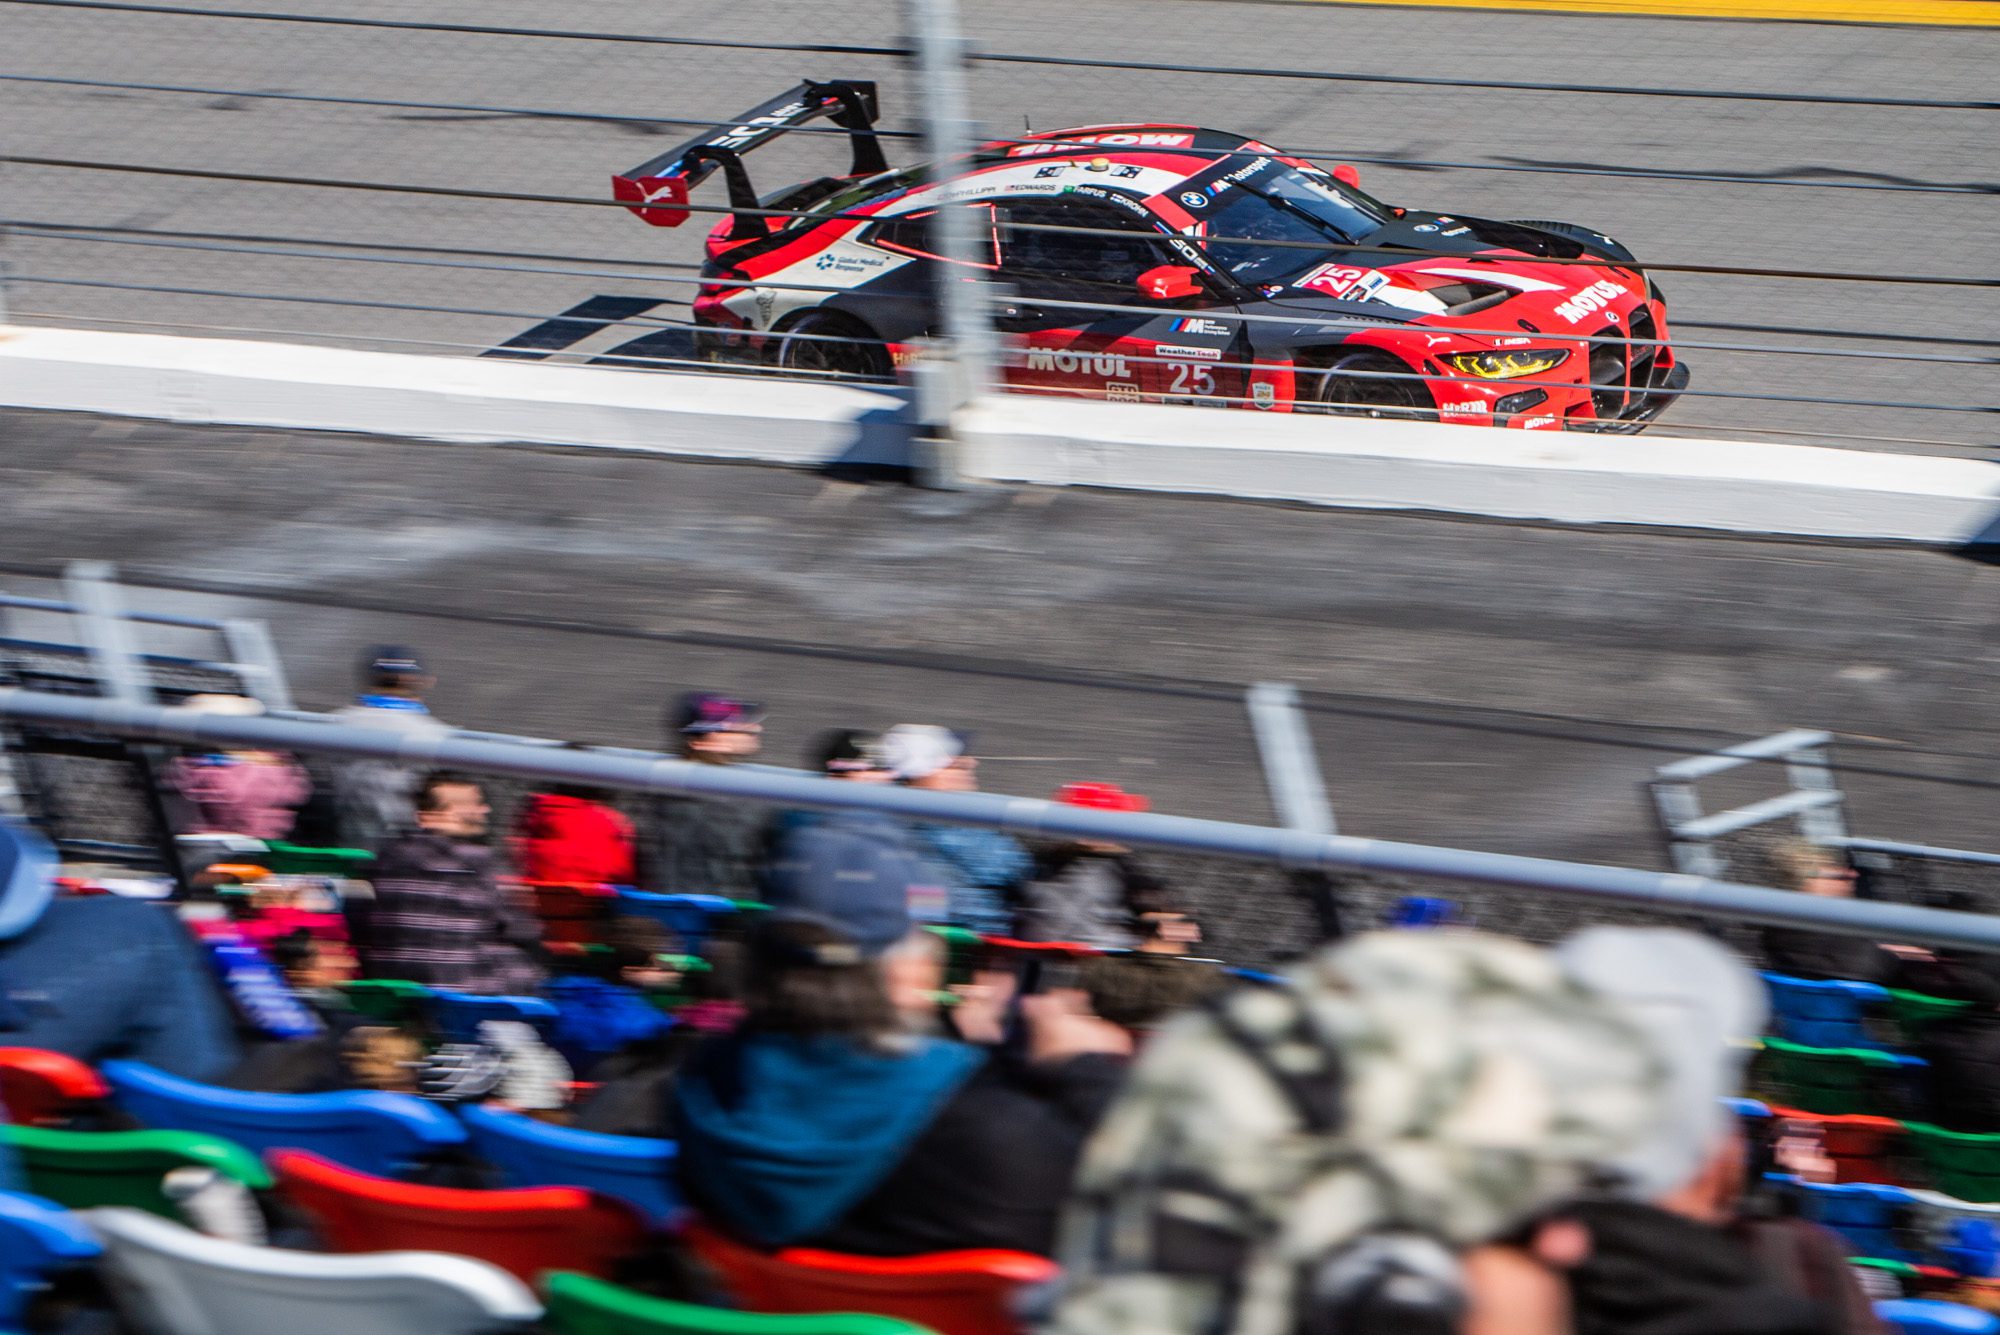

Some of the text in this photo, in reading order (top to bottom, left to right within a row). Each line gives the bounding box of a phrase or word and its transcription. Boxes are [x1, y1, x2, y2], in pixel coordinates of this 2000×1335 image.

[1073, 186, 1107, 198] FARFUS
[860, 258, 884, 266] Medical
[1312, 267, 1362, 293] 25
[1553, 280, 1628, 324] MOTUL
[1504, 337, 1532, 345] IMSA
[1027, 347, 1132, 378] MOTUL
[1167, 363, 1216, 395] 25
[1524, 413, 1555, 429] MOTUL
